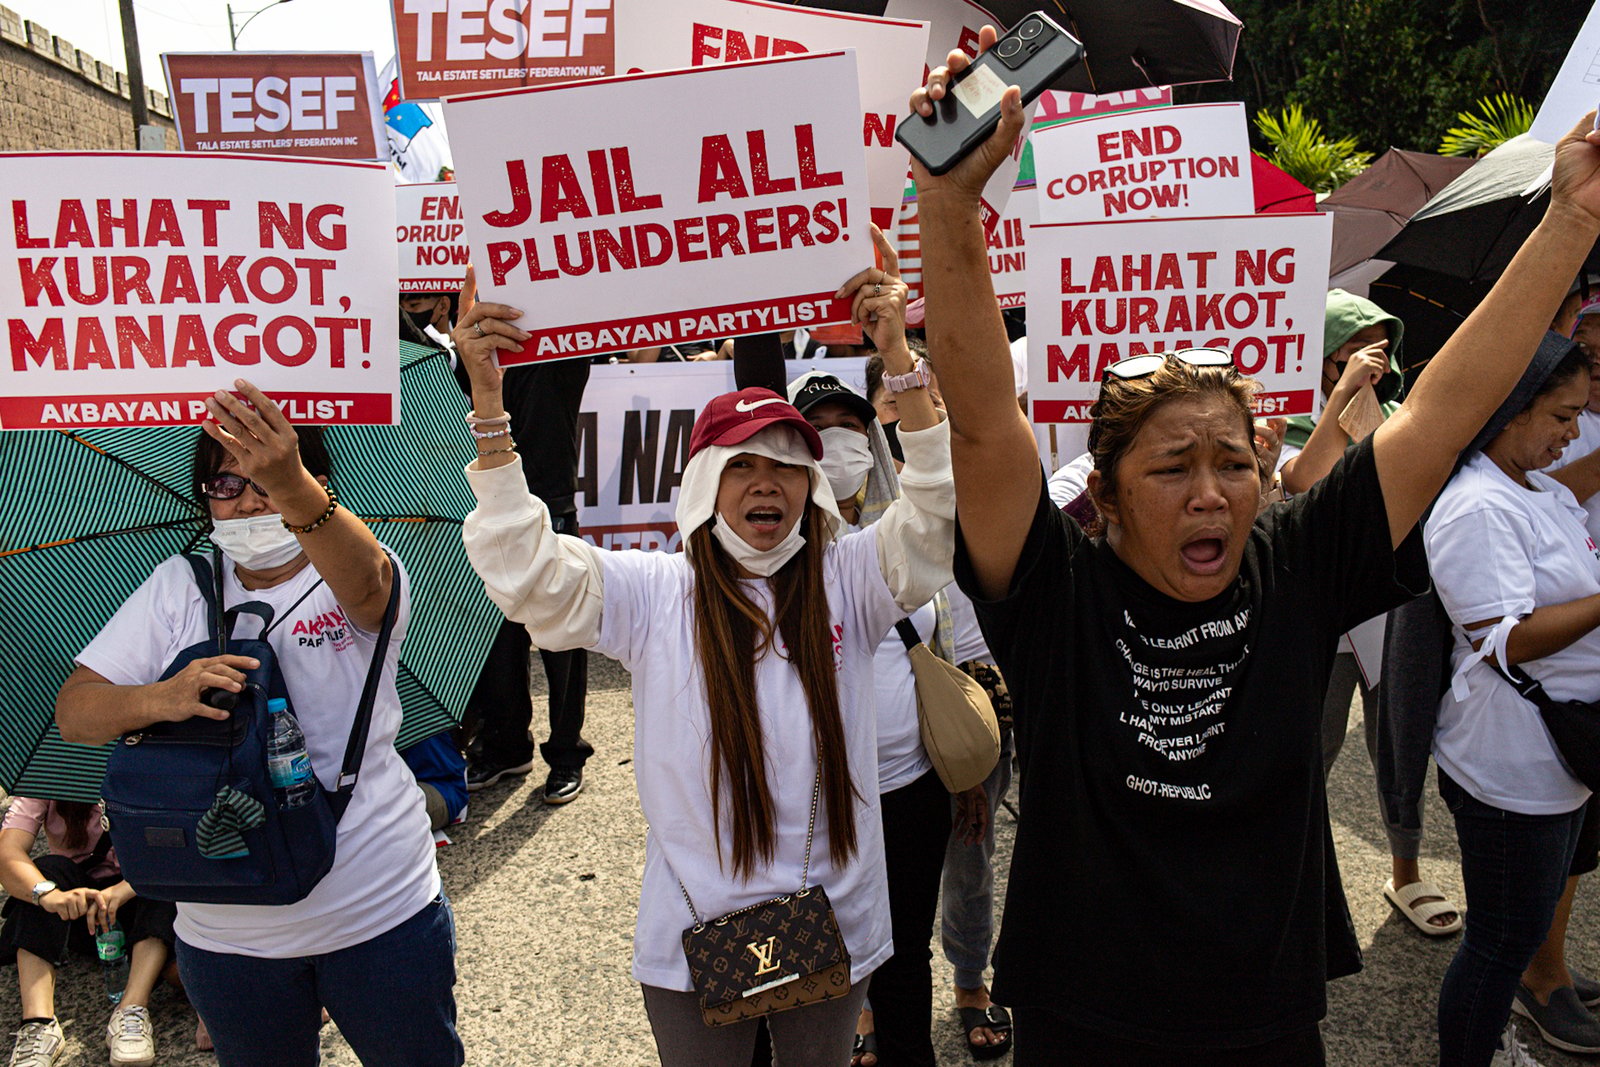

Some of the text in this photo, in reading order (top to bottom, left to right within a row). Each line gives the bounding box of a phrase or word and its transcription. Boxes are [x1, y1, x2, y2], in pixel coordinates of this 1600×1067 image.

[403, 0, 611, 61] TESEF
[417, 65, 605, 82] TALA ESTATE SETTLERS' FEDERATION INC
[180, 76, 357, 133] TESEF
[197, 137, 358, 151] TALA ESTATE SETTLERS' FEDERATION INC
[1097, 125, 1182, 163] END
[483, 146, 664, 228] JAIL
[698, 123, 844, 204] ALL
[1046, 156, 1239, 200] CORRUPTION
[420, 195, 464, 220] EN
[1103, 184, 1189, 217] NOW!
[12, 198, 347, 251] LAHAT NG
[487, 198, 850, 287] PLUNDERERS!
[985, 218, 1025, 250] AIL
[416, 245, 470, 266] NOW
[1061, 251, 1217, 294] LAHAT
[1235, 247, 1296, 287] NG
[17, 254, 352, 314] KURAKOT,
[536, 299, 833, 356] AKBAYAN PARTYLIST
[1061, 291, 1294, 336] KURAKOT,
[7, 312, 372, 372] MANAGOT!
[1047, 333, 1306, 383] MAOT!
[40, 402, 182, 424] AKBAYAN
[1150, 628, 1199, 650] LEARNT
[1200, 619, 1236, 639] FROM
[1150, 668, 1161, 679] IS
[1161, 667, 1185, 678] THE
[1171, 676, 1223, 690] SURVIVE
[1149, 702, 1226, 726] MY MISTAKE
[1151, 702, 1185, 715] ONLY
